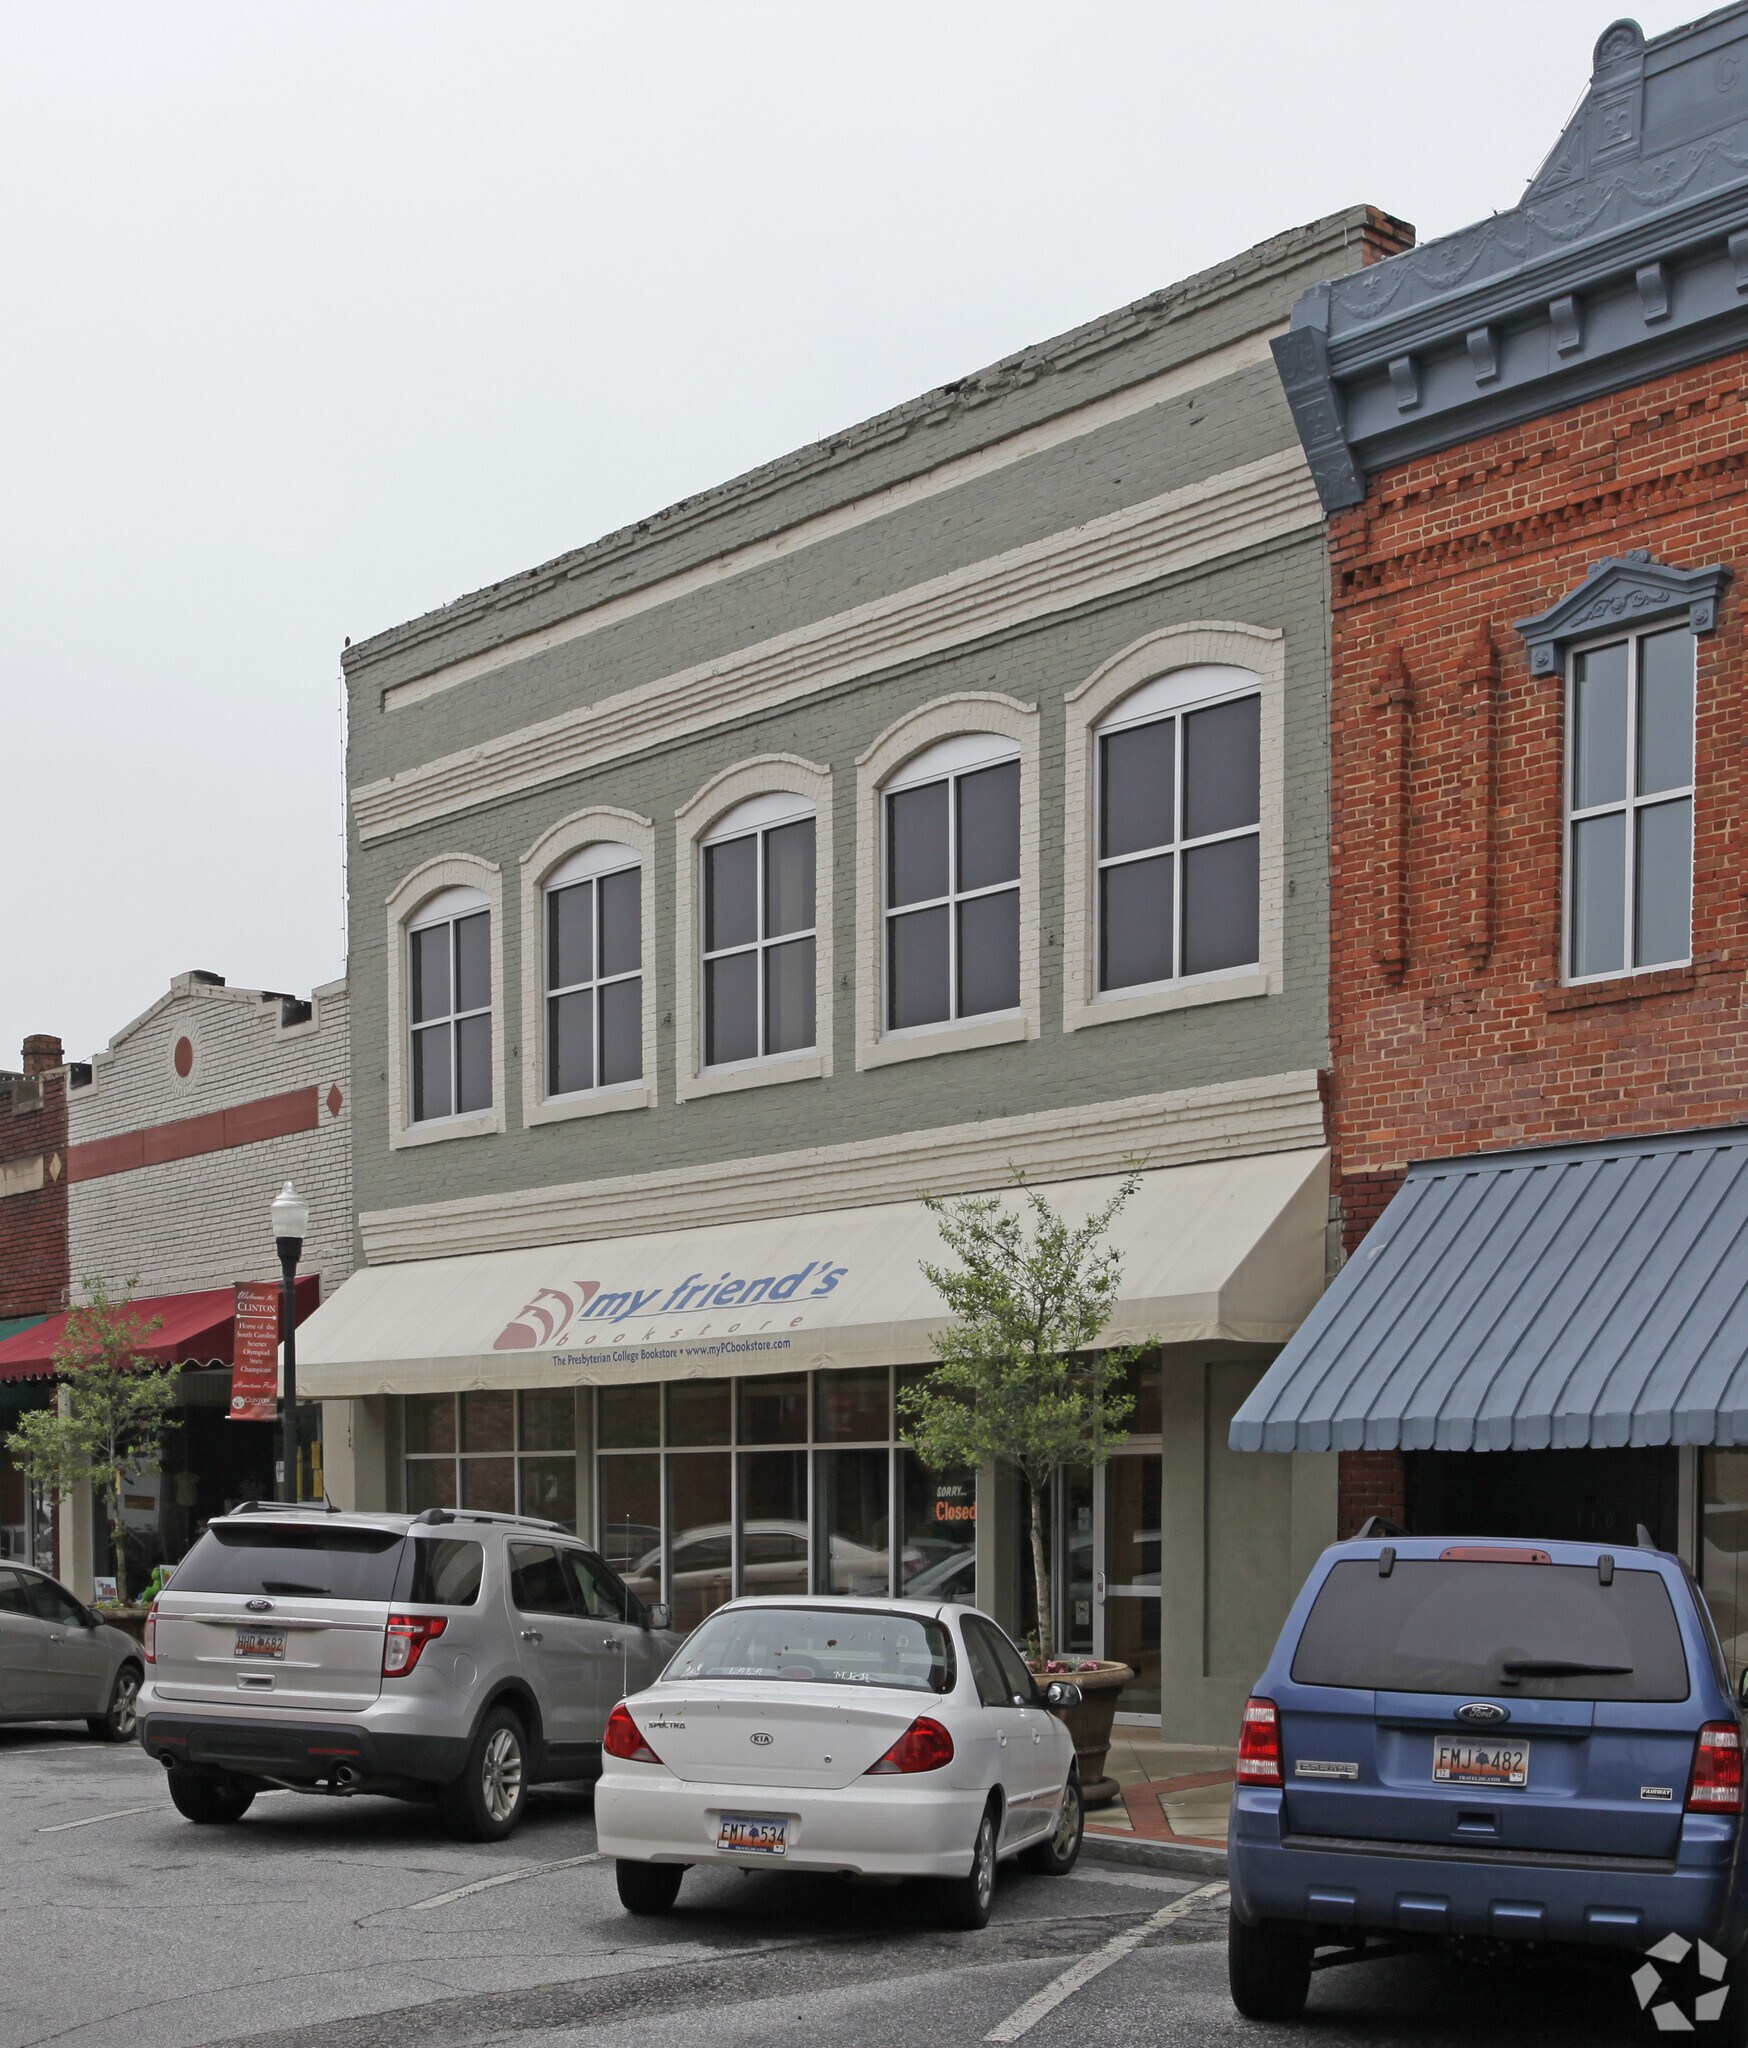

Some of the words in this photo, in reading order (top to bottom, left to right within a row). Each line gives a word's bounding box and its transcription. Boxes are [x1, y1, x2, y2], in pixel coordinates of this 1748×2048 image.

[237, 1291, 265, 1300] Welcome
[580, 1288, 664, 1325] my
[658, 1260, 849, 1312] friend's
[237, 1301, 276, 1313] CLINTON
[239, 1322, 256, 1330] Home
[554, 1315, 804, 1347] bookstore
[253, 1331, 277, 1339] Carolina
[242, 1348, 270, 1357] Olympiad
[552, 1355, 567, 1367] The
[567, 1352, 611, 1367] Presbyterian
[612, 1350, 639, 1364] College
[640, 1348, 678, 1360] Bookstore
[685, 1339, 791, 1357] www.myPCbookstore.com
[240, 1365, 272, 1375] Champions
[244, 1396, 270, 1404] CLINTON
[935, 1500, 977, 1521] Closed
[237, 1635, 256, 1650] HHD
[264, 1637, 284, 1652] 682
[648, 1720, 686, 1729] SPECTRA
[1439, 1747, 1472, 1769] FMJ
[1491, 1750, 1523, 1772] 482
[1300, 1762, 1353, 1773] ESCAPE
[721, 1823, 746, 1842] EMT
[760, 1826, 785, 1844] 534
